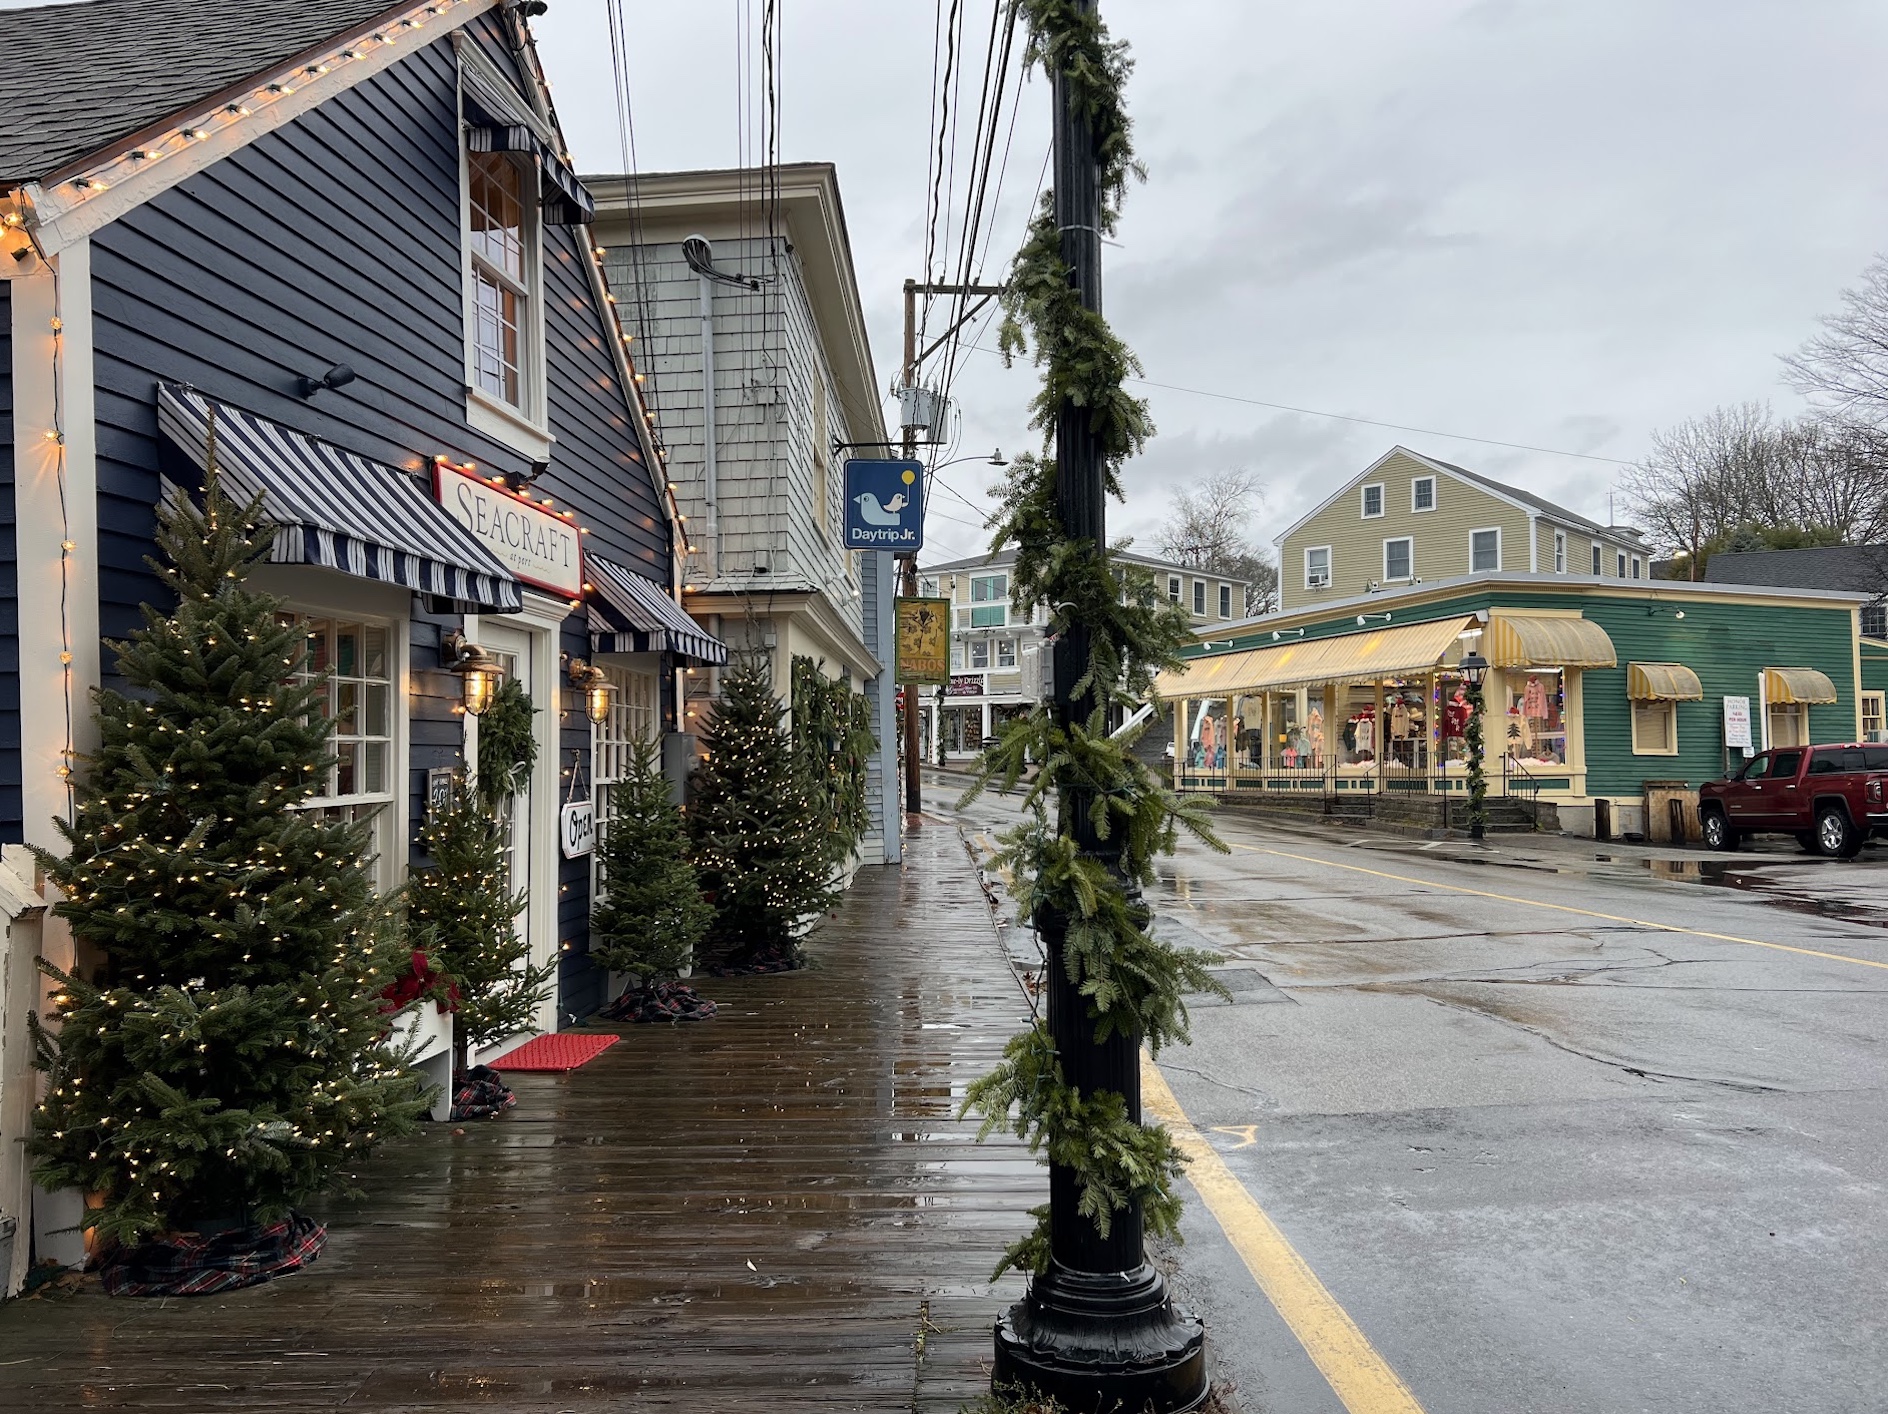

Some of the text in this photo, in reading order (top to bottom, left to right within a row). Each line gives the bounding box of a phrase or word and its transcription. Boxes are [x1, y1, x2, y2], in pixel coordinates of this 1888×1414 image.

[457, 482, 570, 568] SEACRAFT
[852, 527, 916, 543] Daytrip Jr.
